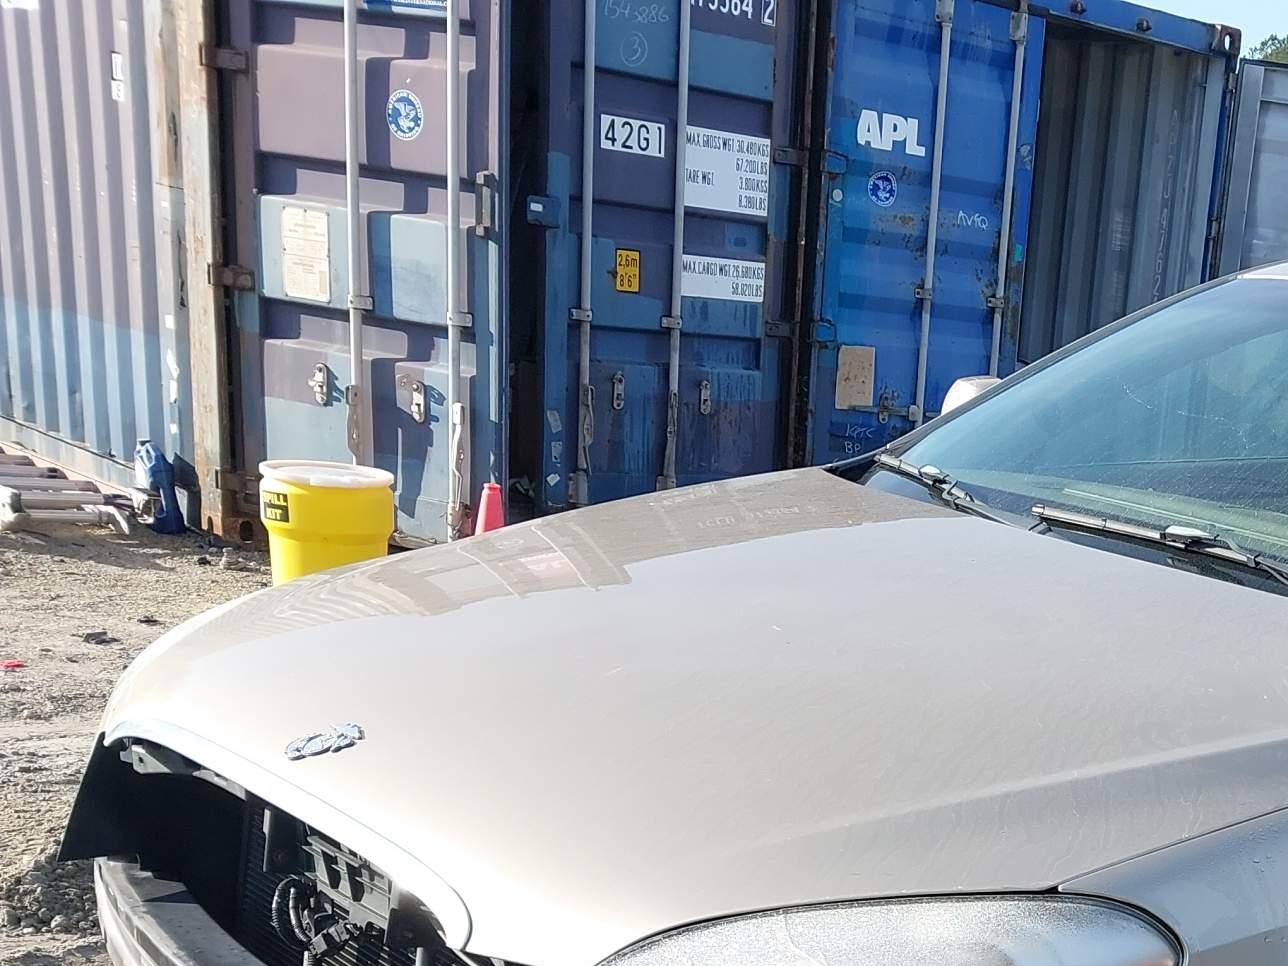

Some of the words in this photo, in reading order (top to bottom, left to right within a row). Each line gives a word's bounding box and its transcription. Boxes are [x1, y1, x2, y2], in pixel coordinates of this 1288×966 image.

[604, 118, 663, 154] 42G1
[702, 133, 721, 151] GROSS
[857, 109, 926, 157] APL
[686, 167, 700, 185] TARE
[263, 492, 287, 506] SPILL
[266, 507, 282, 519] KIT
